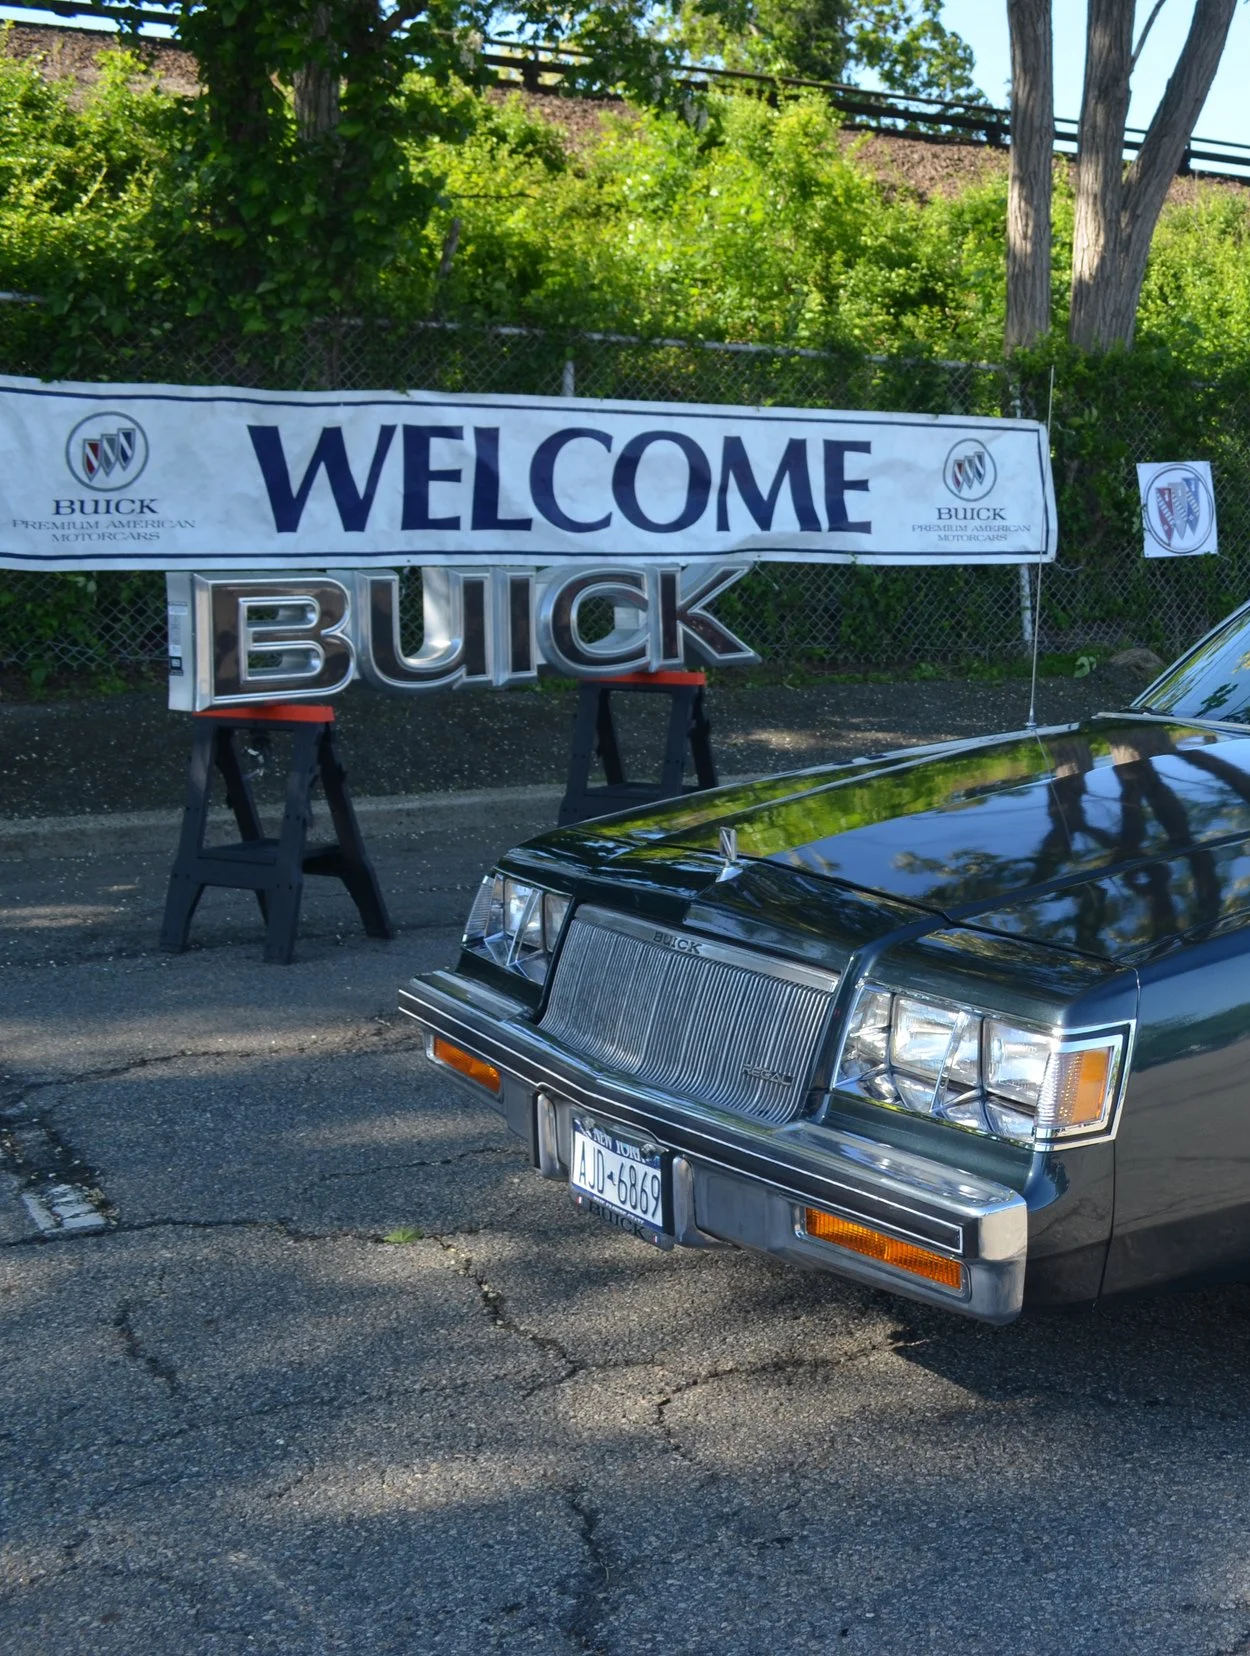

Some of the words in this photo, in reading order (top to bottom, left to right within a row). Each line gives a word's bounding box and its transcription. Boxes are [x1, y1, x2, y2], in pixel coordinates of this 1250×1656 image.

[247, 424, 872, 534] WELCOME
[51, 498, 159, 516] BUICK
[936, 507, 1007, 521] BUICK
[12, 519, 99, 530] PREMIUM
[106, 519, 196, 529] AMERICAN
[912, 524, 967, 533] PREMIUM
[971, 524, 1031, 533] AMERICAN
[51, 531, 160, 542] MOTORCARS
[937, 534, 1008, 542] MOTORCARS
[193, 562, 762, 712] BUICK
[653, 931, 702, 954] BUICK
[742, 1063, 792, 1086] REGAL
[593, 1127, 612, 1150] NEW
[589, 1198, 646, 1240] BUICK
